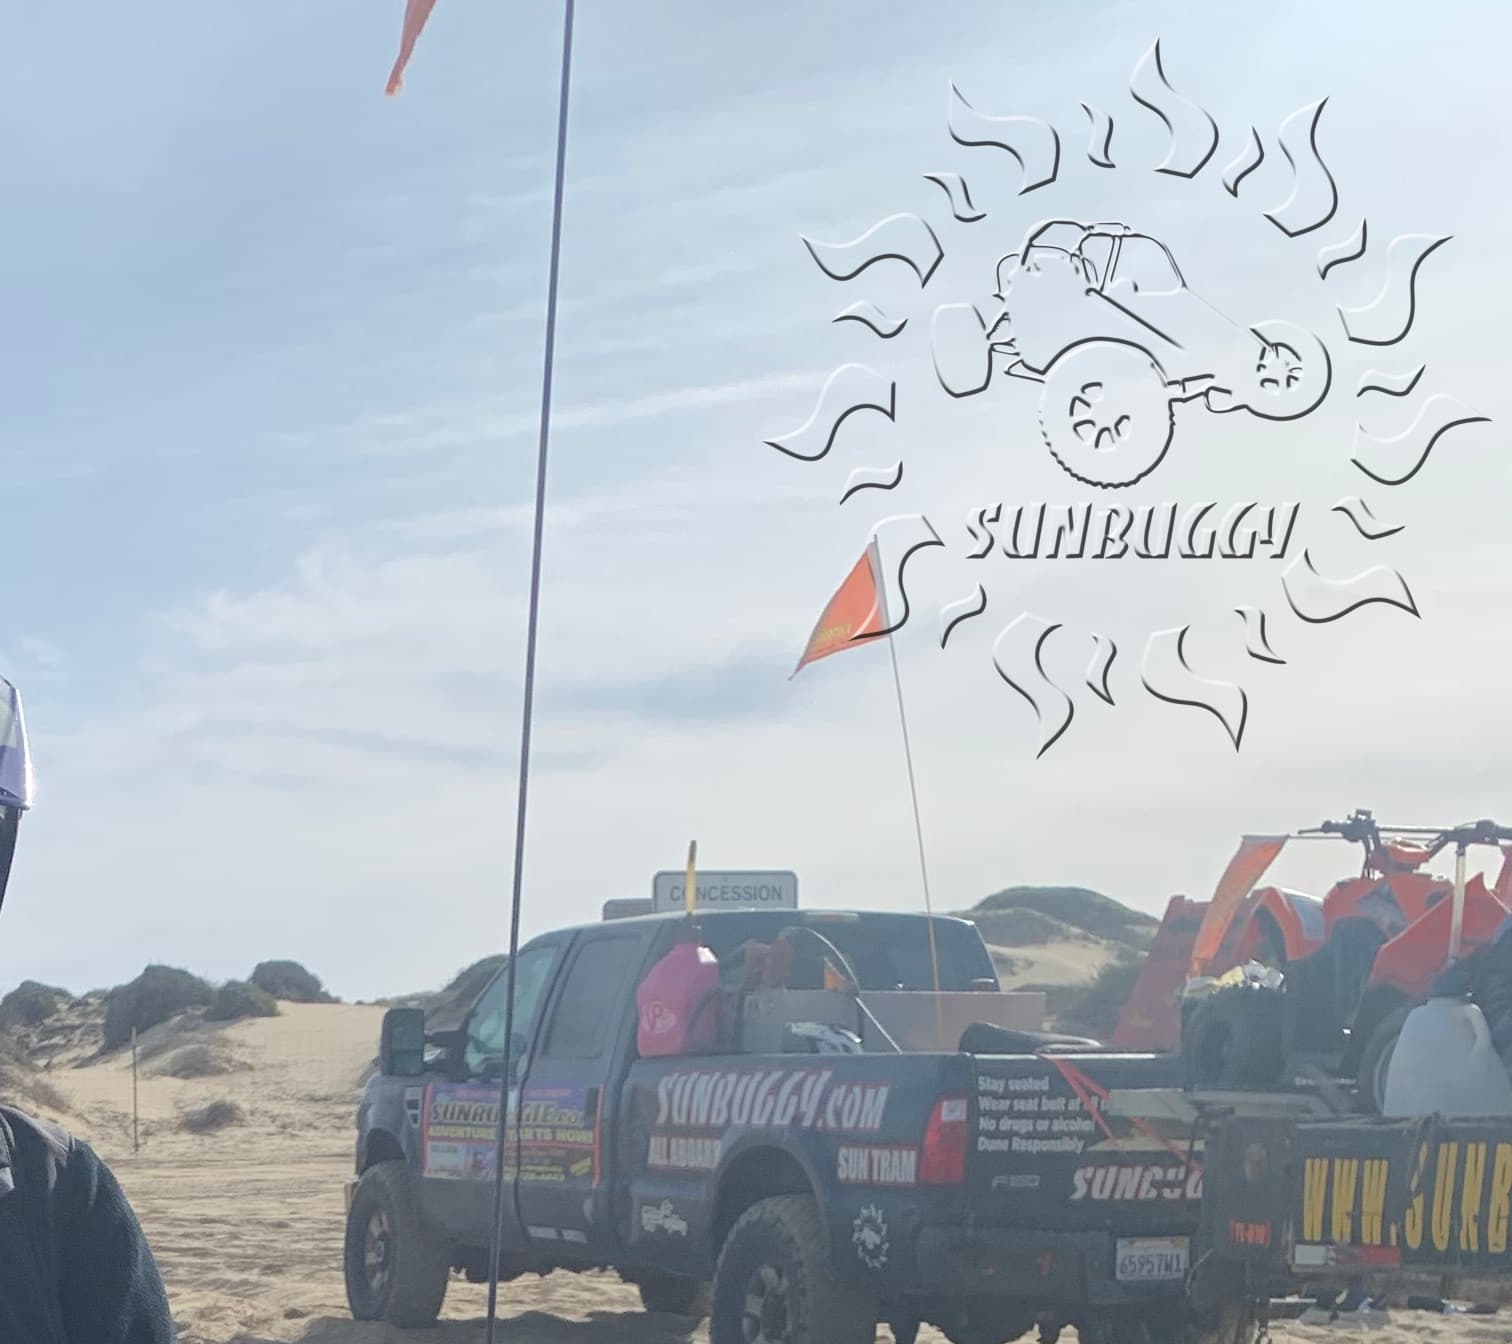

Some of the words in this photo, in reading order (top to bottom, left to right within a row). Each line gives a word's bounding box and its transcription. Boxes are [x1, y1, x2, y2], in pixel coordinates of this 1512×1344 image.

[978, 1075, 1006, 1094] Stay
[1008, 1075, 1050, 1092] seated
[978, 1095, 1010, 1112] Wear
[1013, 1096, 1039, 1112] seat
[1040, 1095, 1066, 1112] belt
[978, 1116, 997, 1132] No
[999, 1116, 1034, 1135] drugs
[1035, 1119, 1050, 1132] or
[977, 1136, 1010, 1152] Dune
[1011, 1136, 1085, 1155] Responsibly
[839, 1147, 869, 1180] SUN
